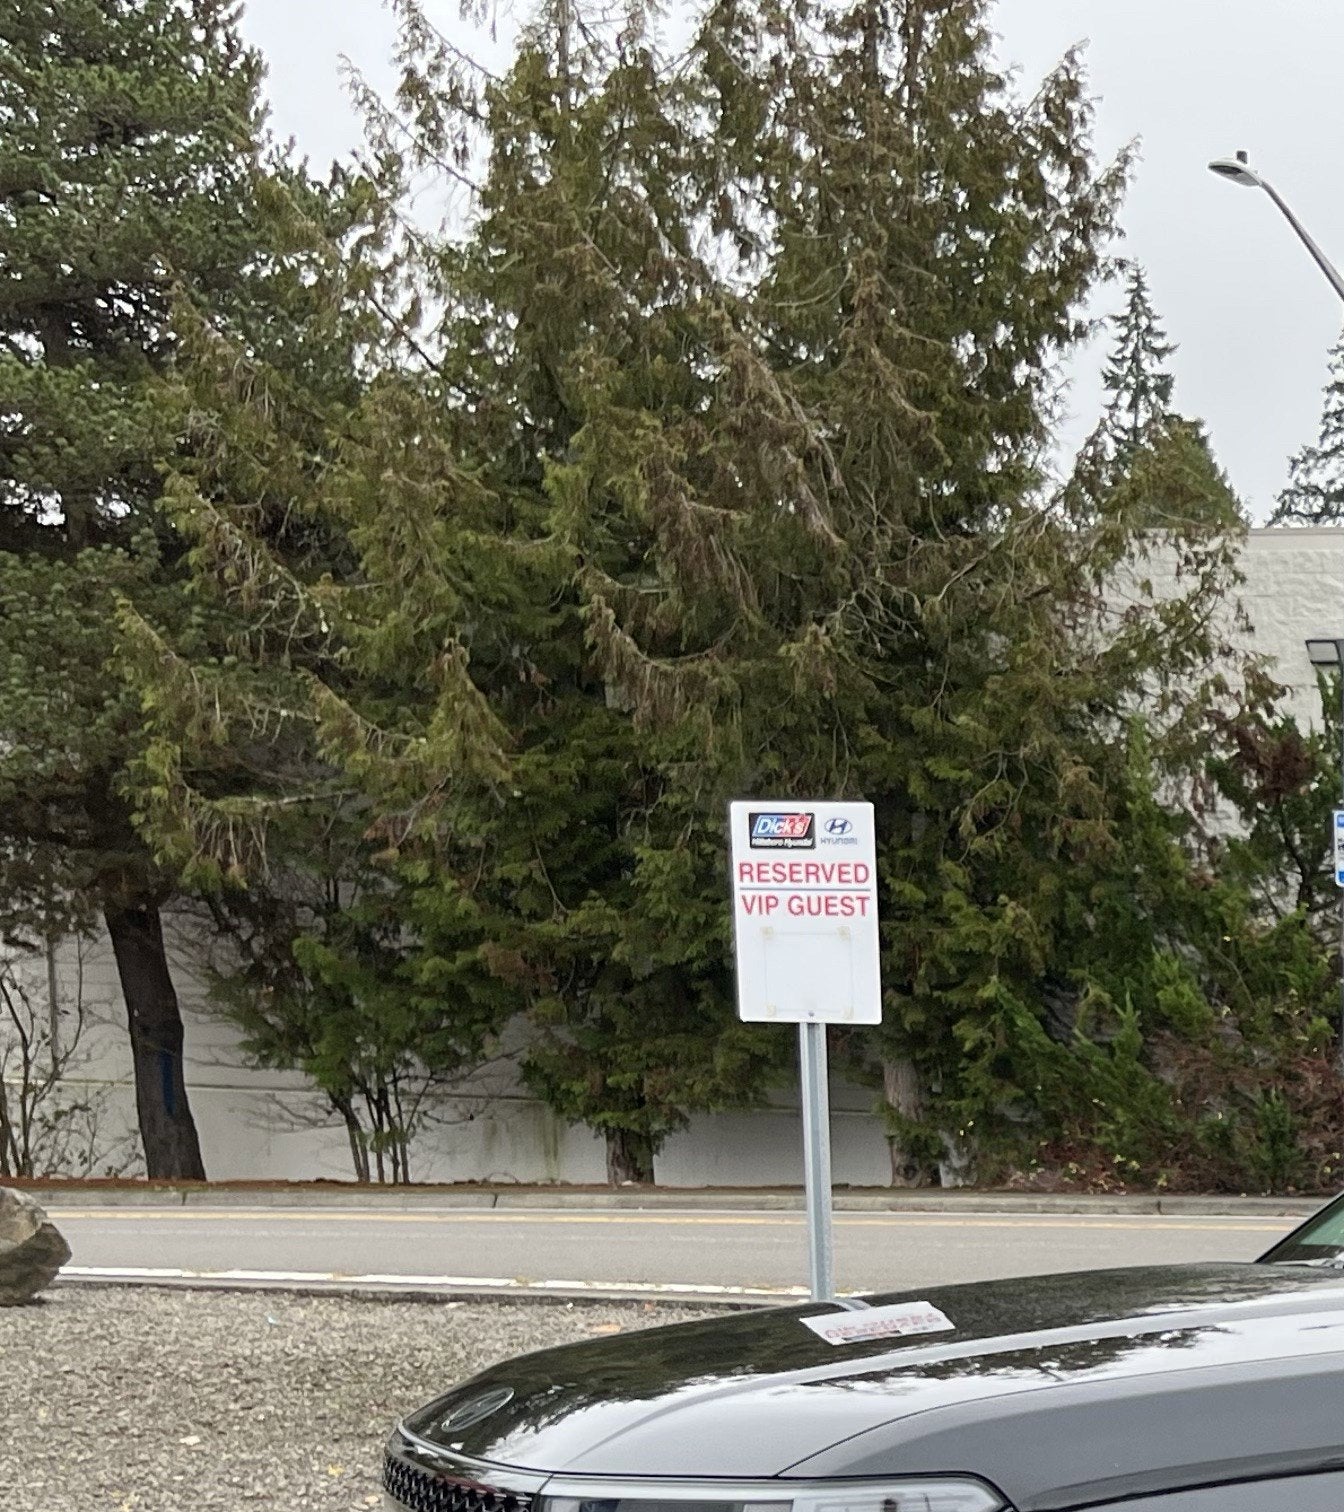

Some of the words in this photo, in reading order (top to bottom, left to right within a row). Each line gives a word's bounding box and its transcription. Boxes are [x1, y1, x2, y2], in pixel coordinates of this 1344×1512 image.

[757, 815, 806, 834] Dick's
[739, 862, 870, 883] RESERVED
[741, 895, 779, 916] VIP
[787, 895, 871, 917] GUEST
